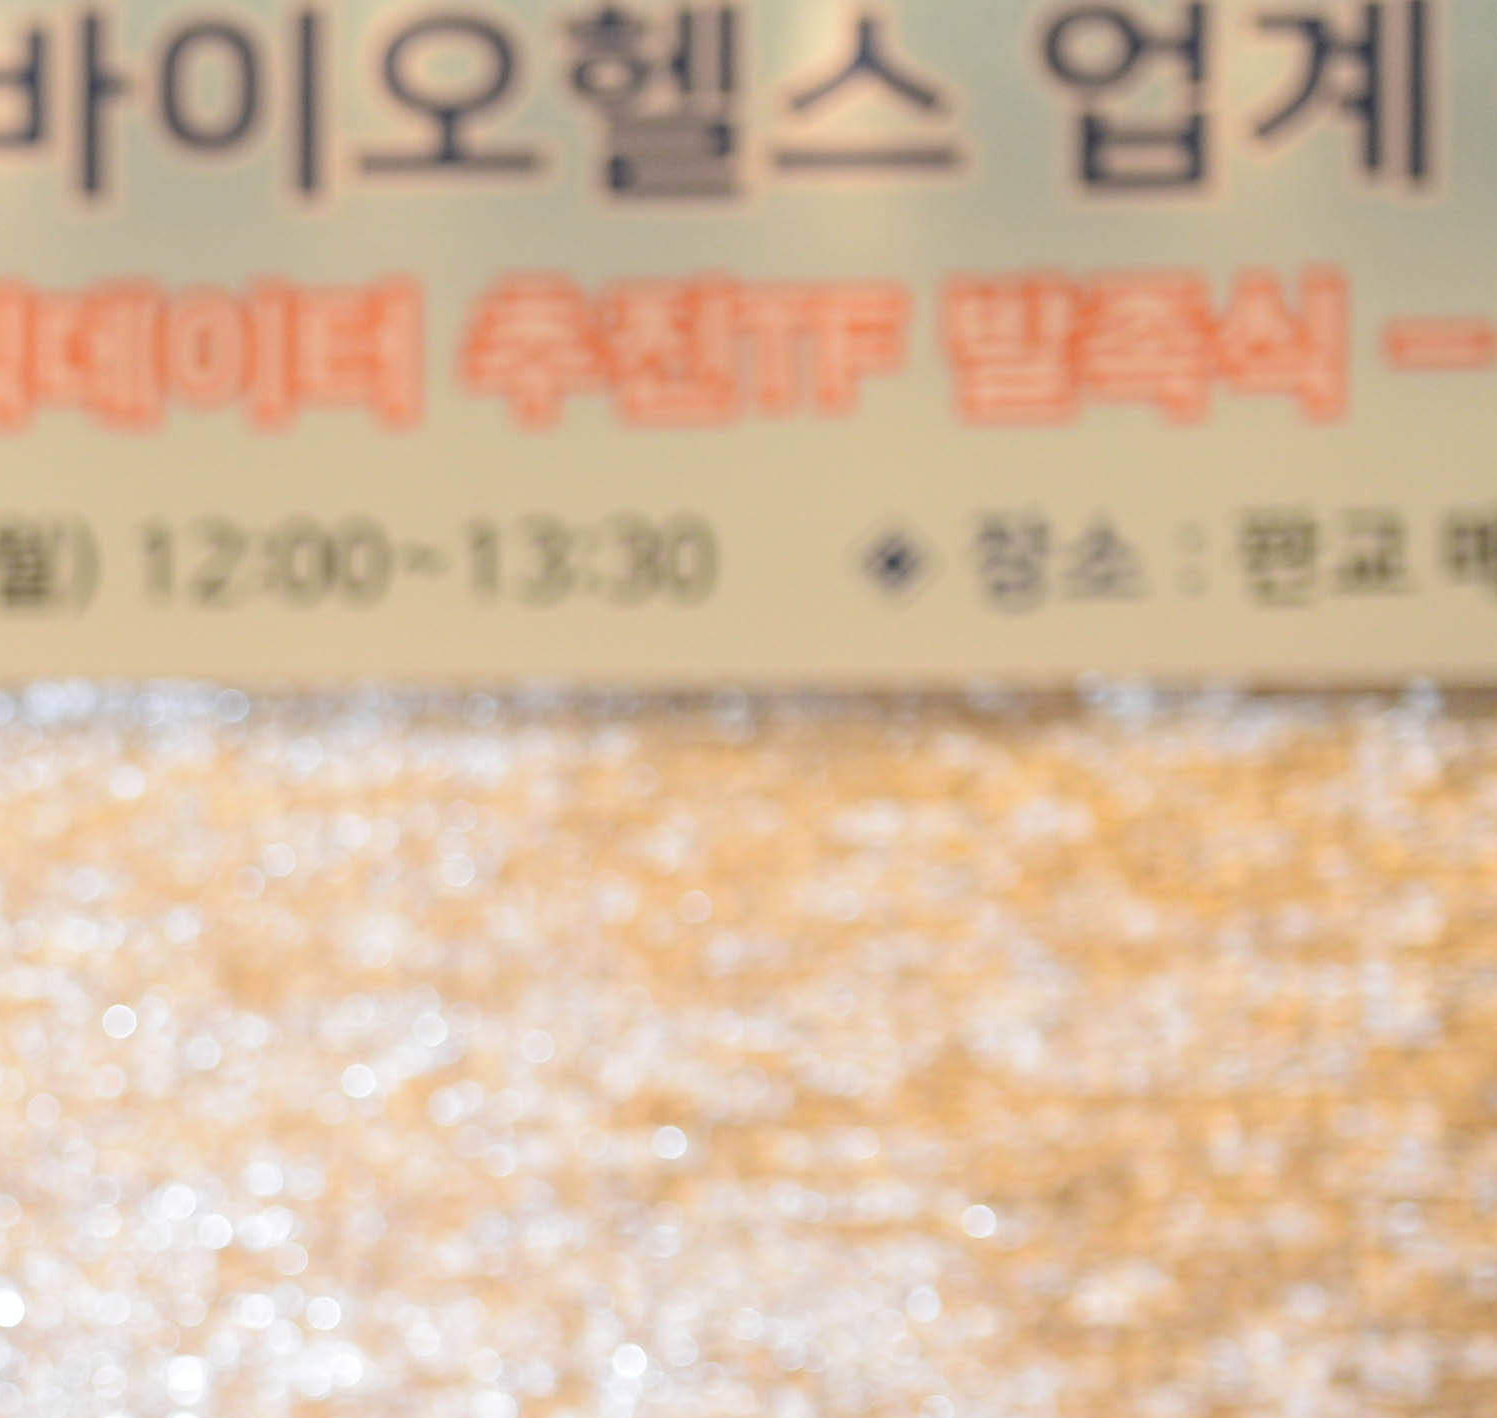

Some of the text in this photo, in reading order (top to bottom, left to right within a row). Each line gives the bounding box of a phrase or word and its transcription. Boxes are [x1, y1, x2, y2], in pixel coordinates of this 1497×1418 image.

[1037, 2, 1433, 195] 업계
[457, 270, 913, 434] 추진TF
[937, 264, 1351, 428] 발족식
[973, 508, 1147, 616] 장소
[1239, 506, 1419, 608] 판교
